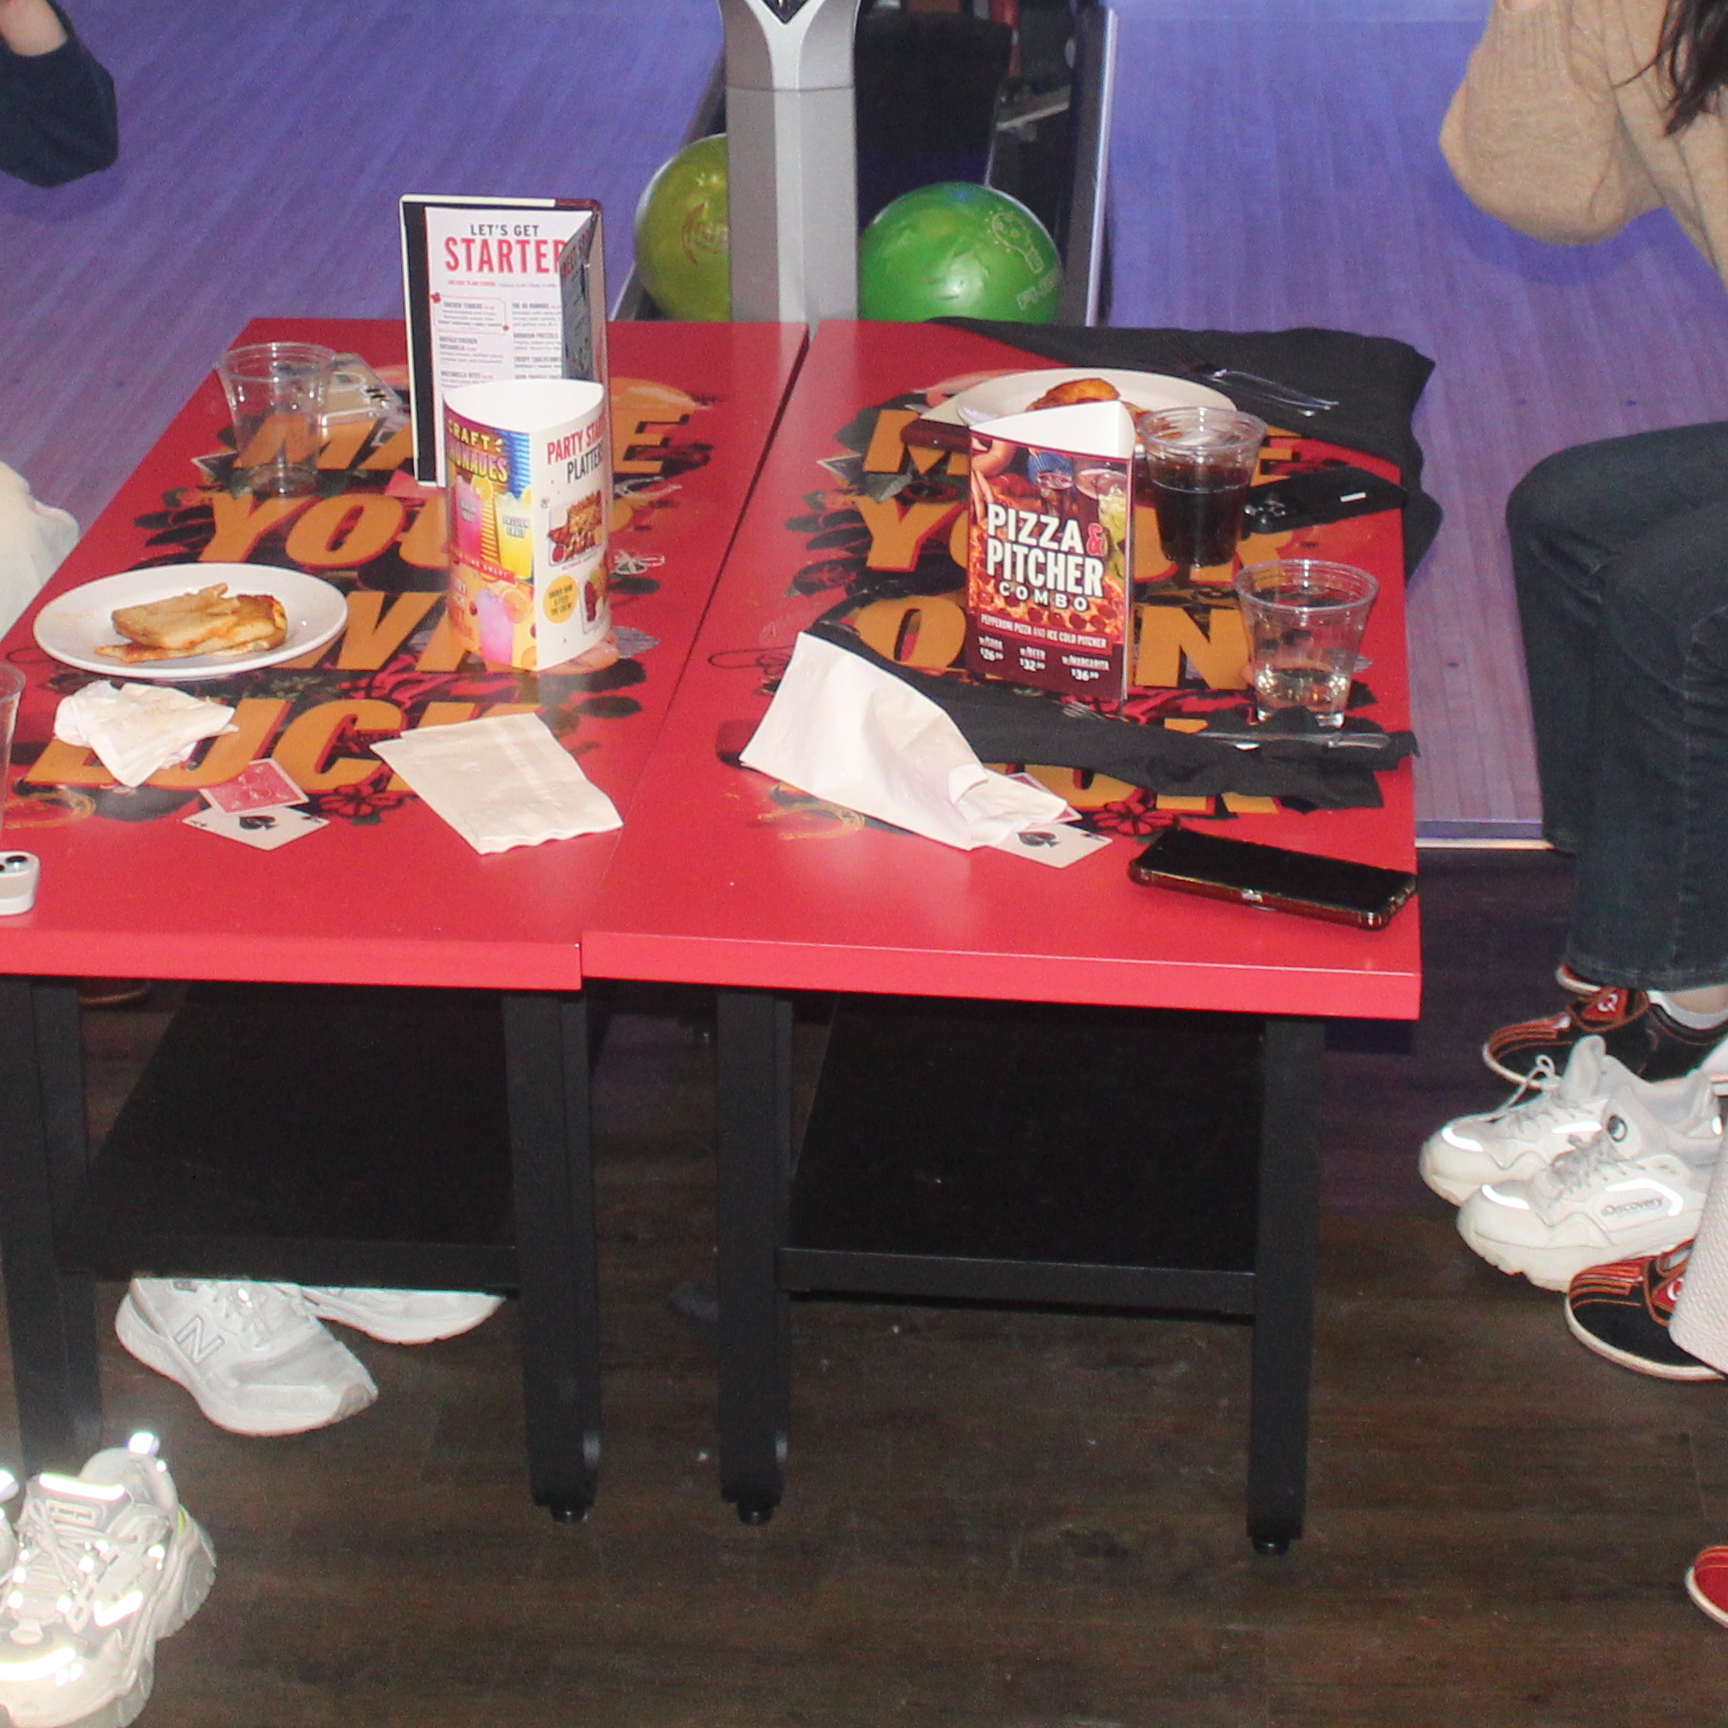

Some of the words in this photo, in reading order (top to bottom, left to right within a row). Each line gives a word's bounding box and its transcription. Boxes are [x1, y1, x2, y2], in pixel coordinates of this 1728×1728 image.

[470, 224, 508, 237] LET'S
[513, 224, 540, 237] GET
[546, 430, 584, 465] PARTY
[987, 503, 1085, 555] PIZZA
[1085, 522, 1104, 557] &
[986, 537, 1104, 598] PITCHER
[998, 580, 1089, 612] COMBO
